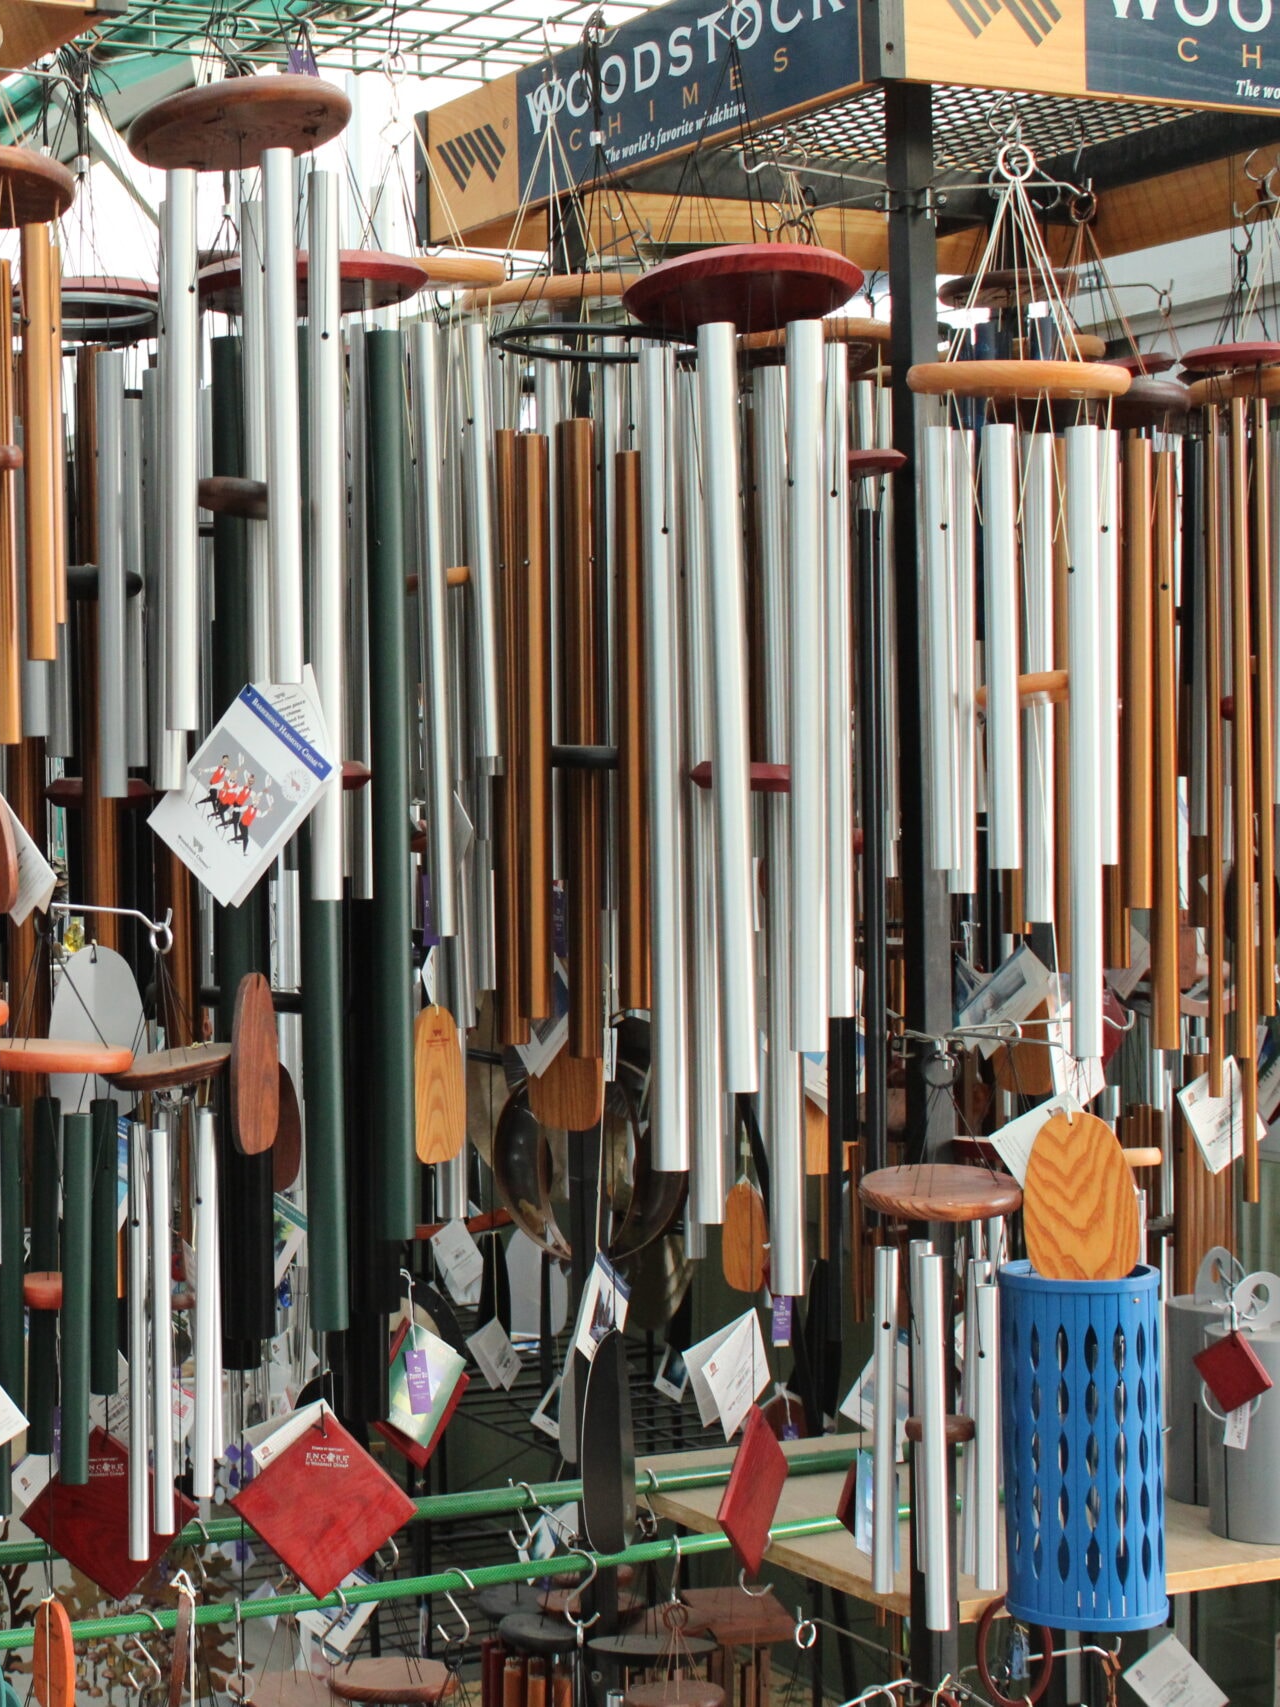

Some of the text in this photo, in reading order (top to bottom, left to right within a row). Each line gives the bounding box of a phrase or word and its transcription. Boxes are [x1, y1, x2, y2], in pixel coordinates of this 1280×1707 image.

[570, 48, 789, 150] CHIMES
[1236, 79, 1260, 97] The
[604, 145, 620, 164] The
[622, 130, 655, 158] world's
[655, 119, 694, 151] favorite
